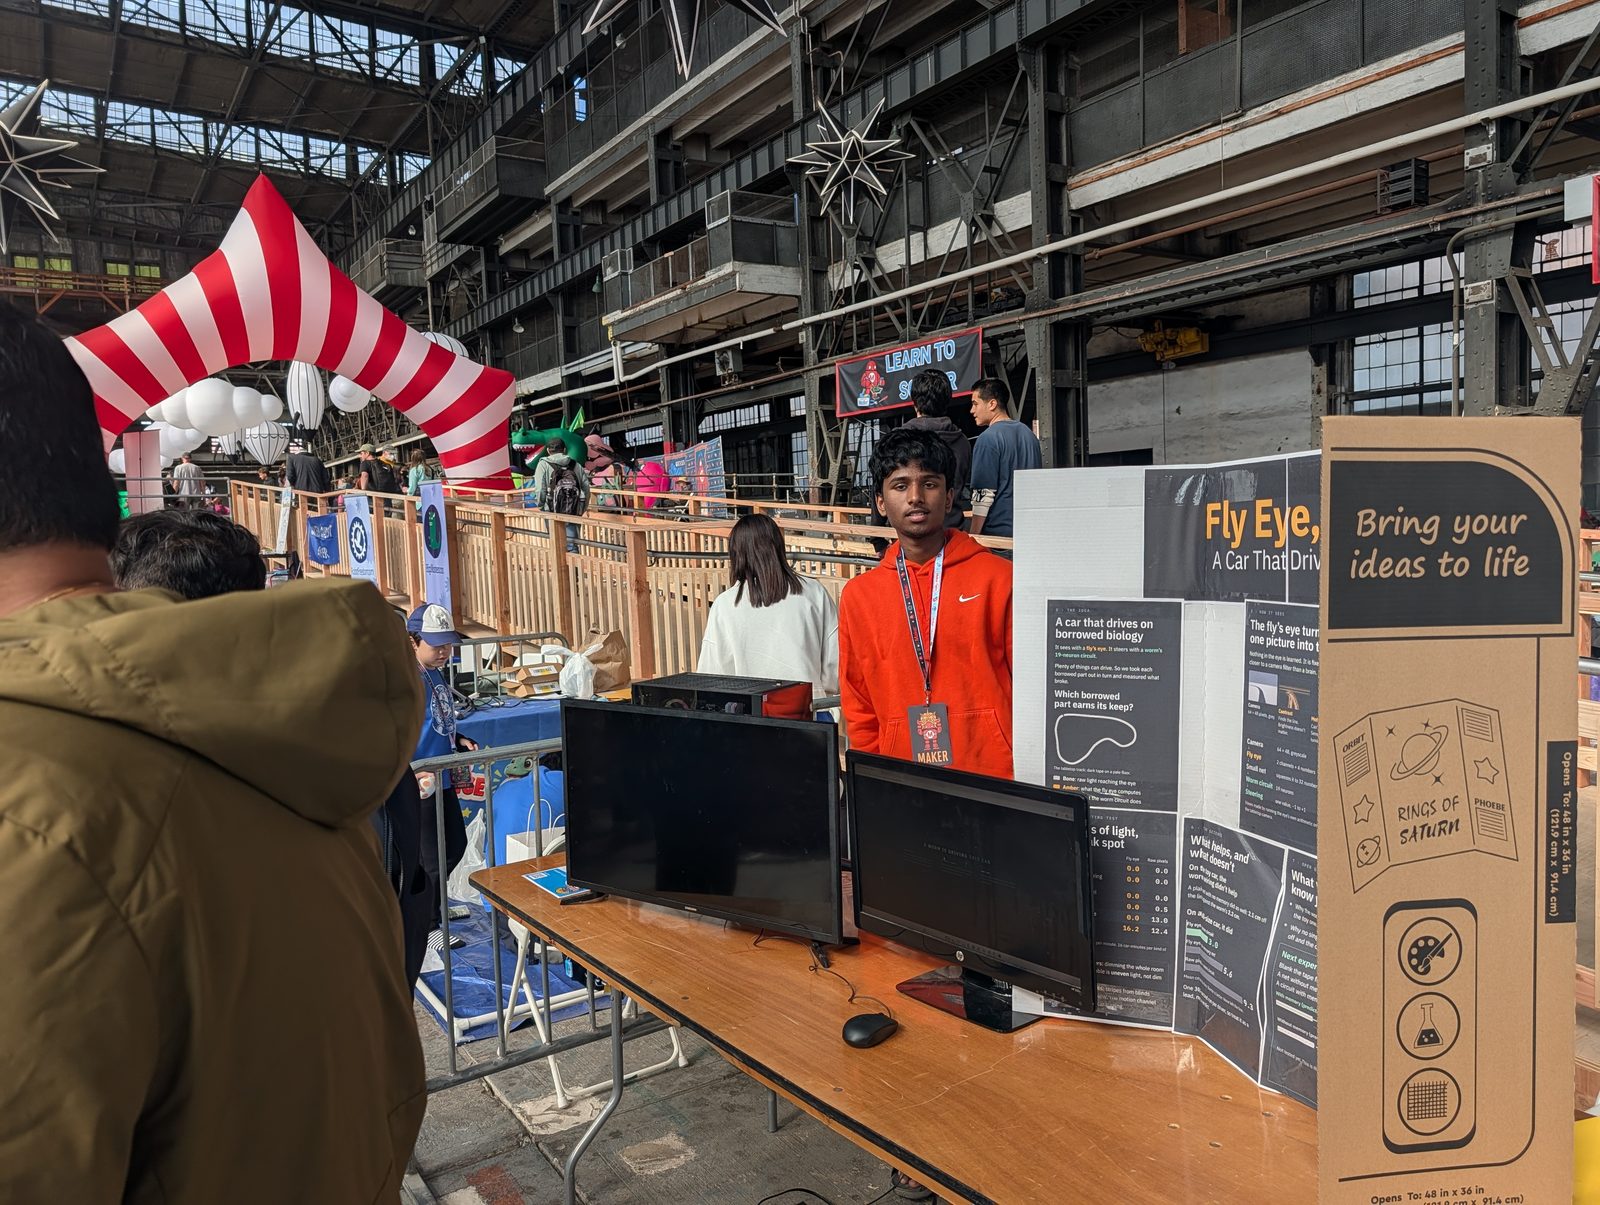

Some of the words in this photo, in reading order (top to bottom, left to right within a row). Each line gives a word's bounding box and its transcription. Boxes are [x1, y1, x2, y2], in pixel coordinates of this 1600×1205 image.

[885, 345, 932, 373] LEARN
[934, 339, 956, 361] TO
[1205, 500, 1247, 549] Fly
[1255, 498, 1320, 549] Eye,
[1356, 506, 1440, 545] Bring
[1452, 514, 1528, 545] your
[1212, 551, 1222, 570] A
[1225, 550, 1249, 571] Car
[1252, 550, 1287, 571] That
[1350, 548, 1426, 579] ideas
[1437, 551, 1470, 577] to
[1484, 545, 1530, 578] life
[1055, 617, 1063, 627] A
[1065, 618, 1081, 627] car
[1083, 618, 1104, 628] that
[1106, 618, 1138, 629] drives
[1141, 620, 1153, 629] on
[1250, 619, 1265, 631] The
[1266, 620, 1284, 635] fly's
[1285, 625, 1300, 637] eye
[1055, 629, 1103, 640] borrowed
[1106, 630, 1144, 643] biology
[1250, 635, 1264, 645] one
[1266, 635, 1295, 649] picture
[1297, 638, 1314, 652] into
[1054, 690, 1080, 699] Which
[1081, 691, 1120, 701] borrowed
[1054, 700, 1071, 709] part
[1072, 702, 1095, 710] earns
[1097, 702, 1107, 710] its
[1109, 702, 1134, 712] keep?
[1247, 738, 1264, 748] Camera
[1342, 733, 1366, 753] ORBIT
[917, 750, 948, 764] MAKER
[1562, 752, 1572, 786] Opens
[1097, 778, 1118, 786] reaching
[1118, 788, 1141, 796] computes
[1474, 798, 1506, 812] PHOEBE
[1563, 792, 1572, 808] To:
[1398, 800, 1437, 821] RINGS
[1442, 795, 1459, 812] OF
[1550, 808, 1560, 838] (121.9
[1563, 810, 1572, 824] 48
[1099, 825, 1109, 835] of
[1112, 825, 1139, 839] light,
[1562, 826, 1572, 836] in
[1102, 839, 1125, 850] spot
[1191, 835, 1211, 849] What
[1211, 840, 1233, 860] helps,
[1234, 851, 1250, 864] and
[1550, 841, 1558, 858] cm
[1562, 839, 1569, 847] x
[1190, 848, 1209, 861] what
[1209, 854, 1235, 872] doesn't
[1562, 848, 1571, 862] 36
[1562, 864, 1572, 874] in
[1291, 869, 1314, 888] What
[1550, 872, 1559, 893] 91.4
[1291, 883, 1314, 903] know
[1549, 897, 1559, 917] cm)
[1151, 916, 1169, 924] 13.0
[1122, 925, 1140, 933] 16.2
[1151, 927, 1169, 935] 12.4
[1290, 925, 1301, 934] Why
[1208, 938, 1219, 949] 3.0
[1295, 936, 1305, 945] and
[1306, 940, 1314, 949] the
[1281, 950, 1298, 963] Next
[1223, 967, 1233, 978] 5.6
[1293, 967, 1302, 976] the
[1302, 971, 1314, 981] tape
[1243, 999, 1254, 1011] 9.3
[1370, 1194, 1402, 1205] Opens
[1407, 1191, 1422, 1201] To:
[1424, 1189, 1437, 1199] 48
[1440, 1188, 1449, 1198] in
[1461, 1187, 1472, 1196] 36
[1475, 1185, 1485, 1195] in
[1482, 1196, 1502, 1205] 91.4
[1505, 1194, 1524, 1204] cm)
